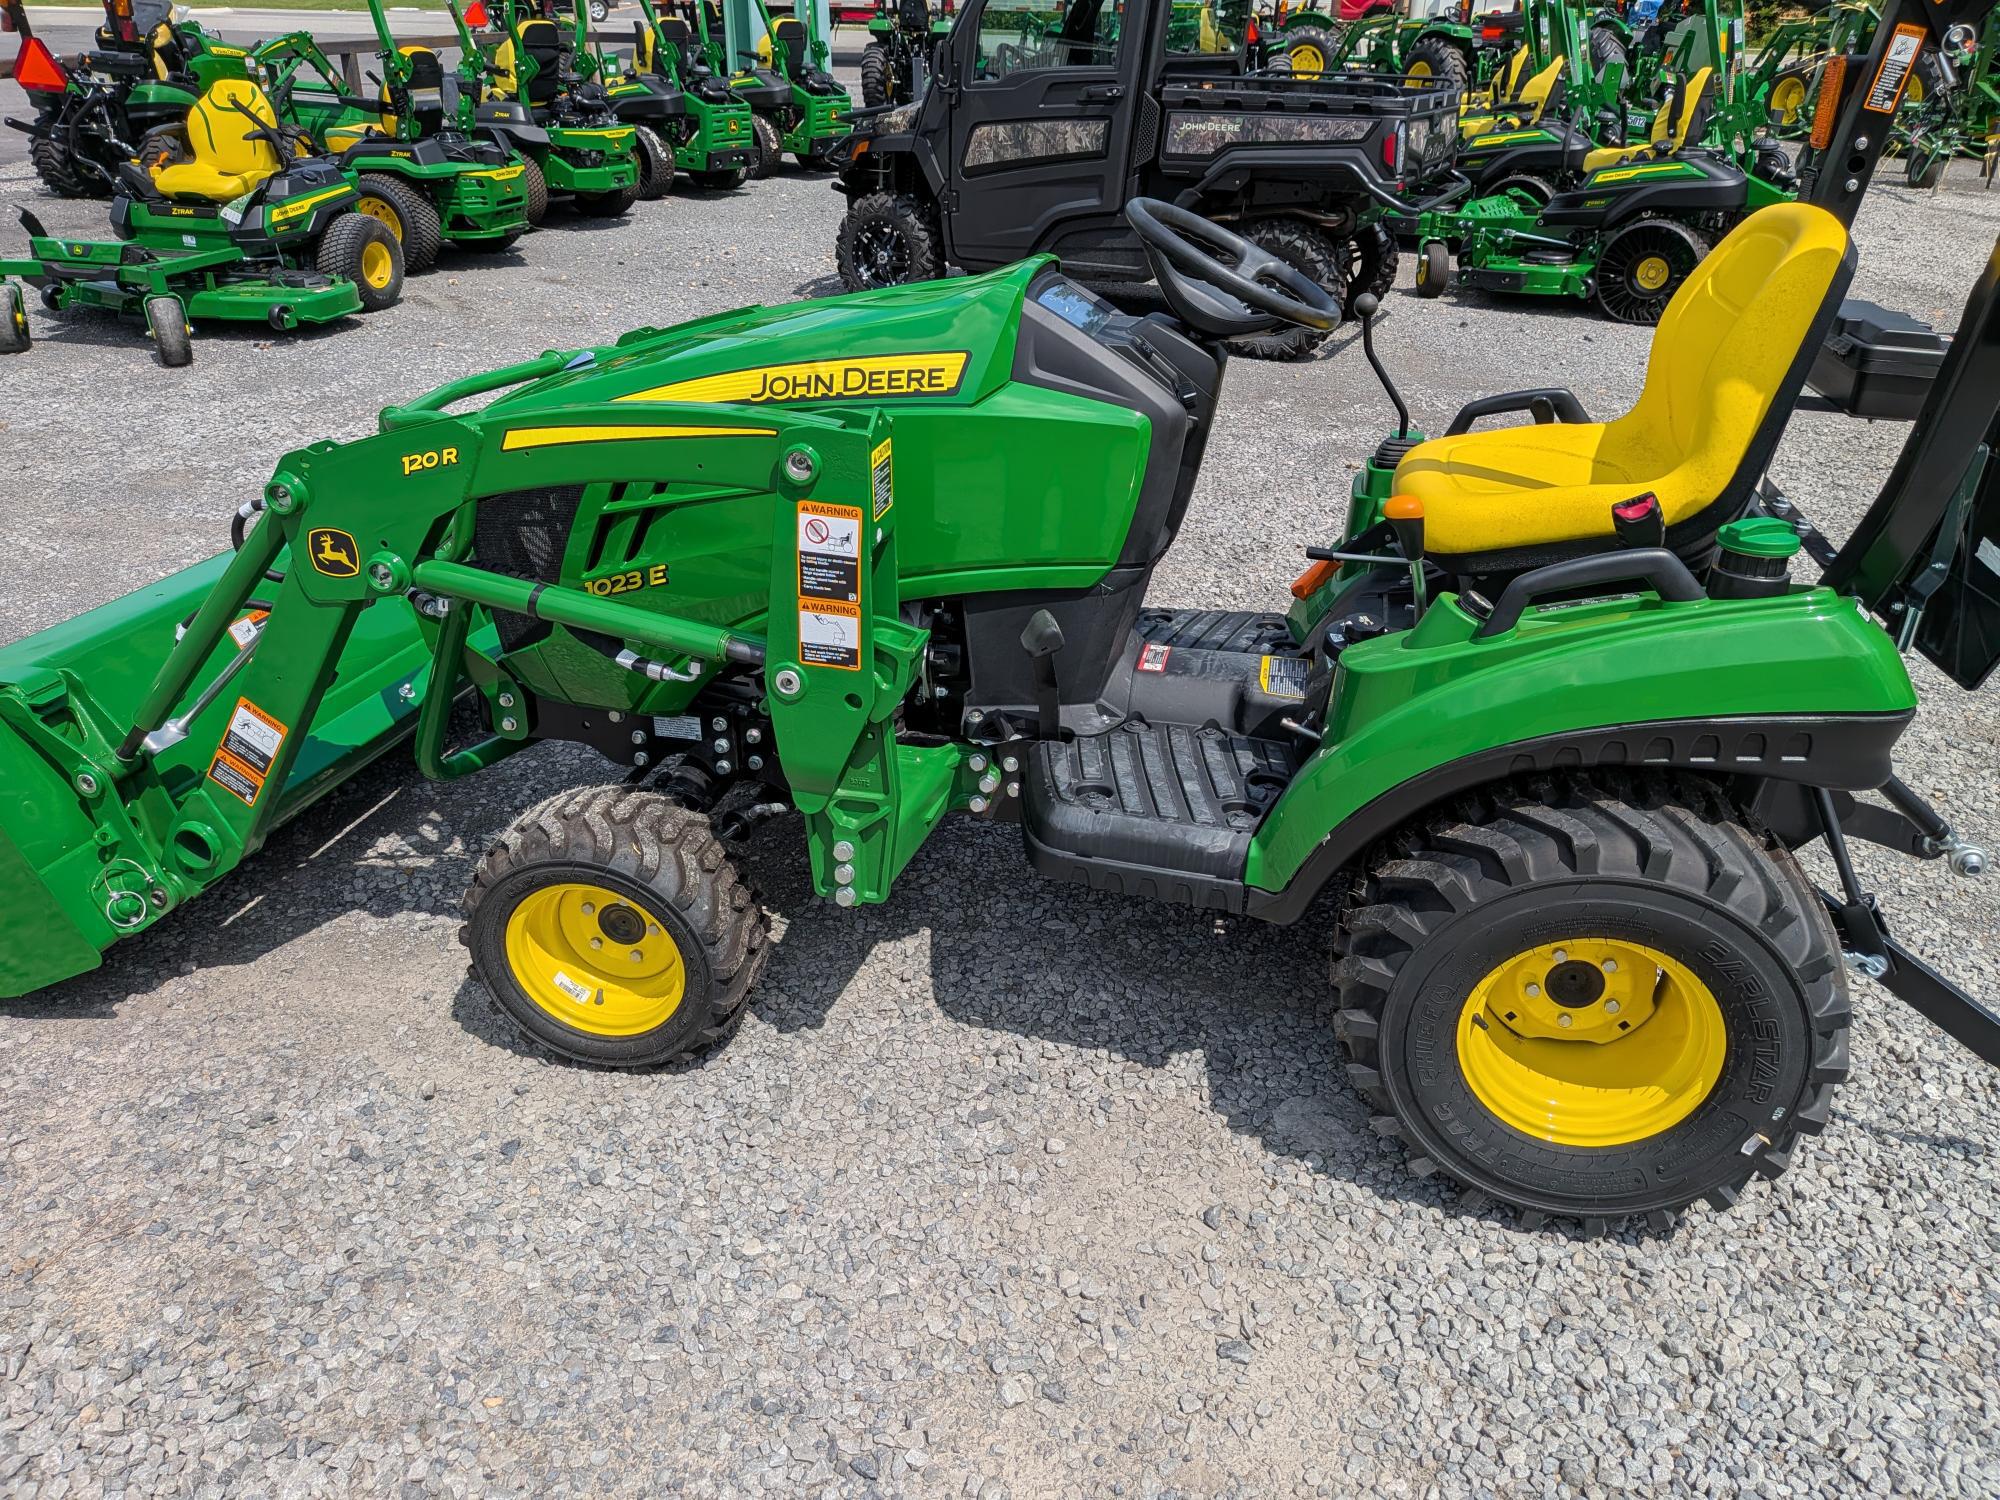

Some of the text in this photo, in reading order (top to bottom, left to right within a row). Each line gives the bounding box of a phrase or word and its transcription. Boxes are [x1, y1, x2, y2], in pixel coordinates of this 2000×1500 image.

[1180, 121, 1241, 132] JOHN DEERE
[391, 150, 411, 158] ZTRAK
[172, 207, 195, 215] ZTRAK
[275, 204, 305, 218] JOHN DEERE
[750, 367, 947, 399] JOHN DEERE
[402, 447, 458, 476] 120 R
[811, 504, 858, 518] WARNING
[584, 564, 668, 596] 1023 E
[811, 602, 857, 616] WARNING
[252, 707, 282, 731] WARNING
[229, 760, 259, 783] WARNING
